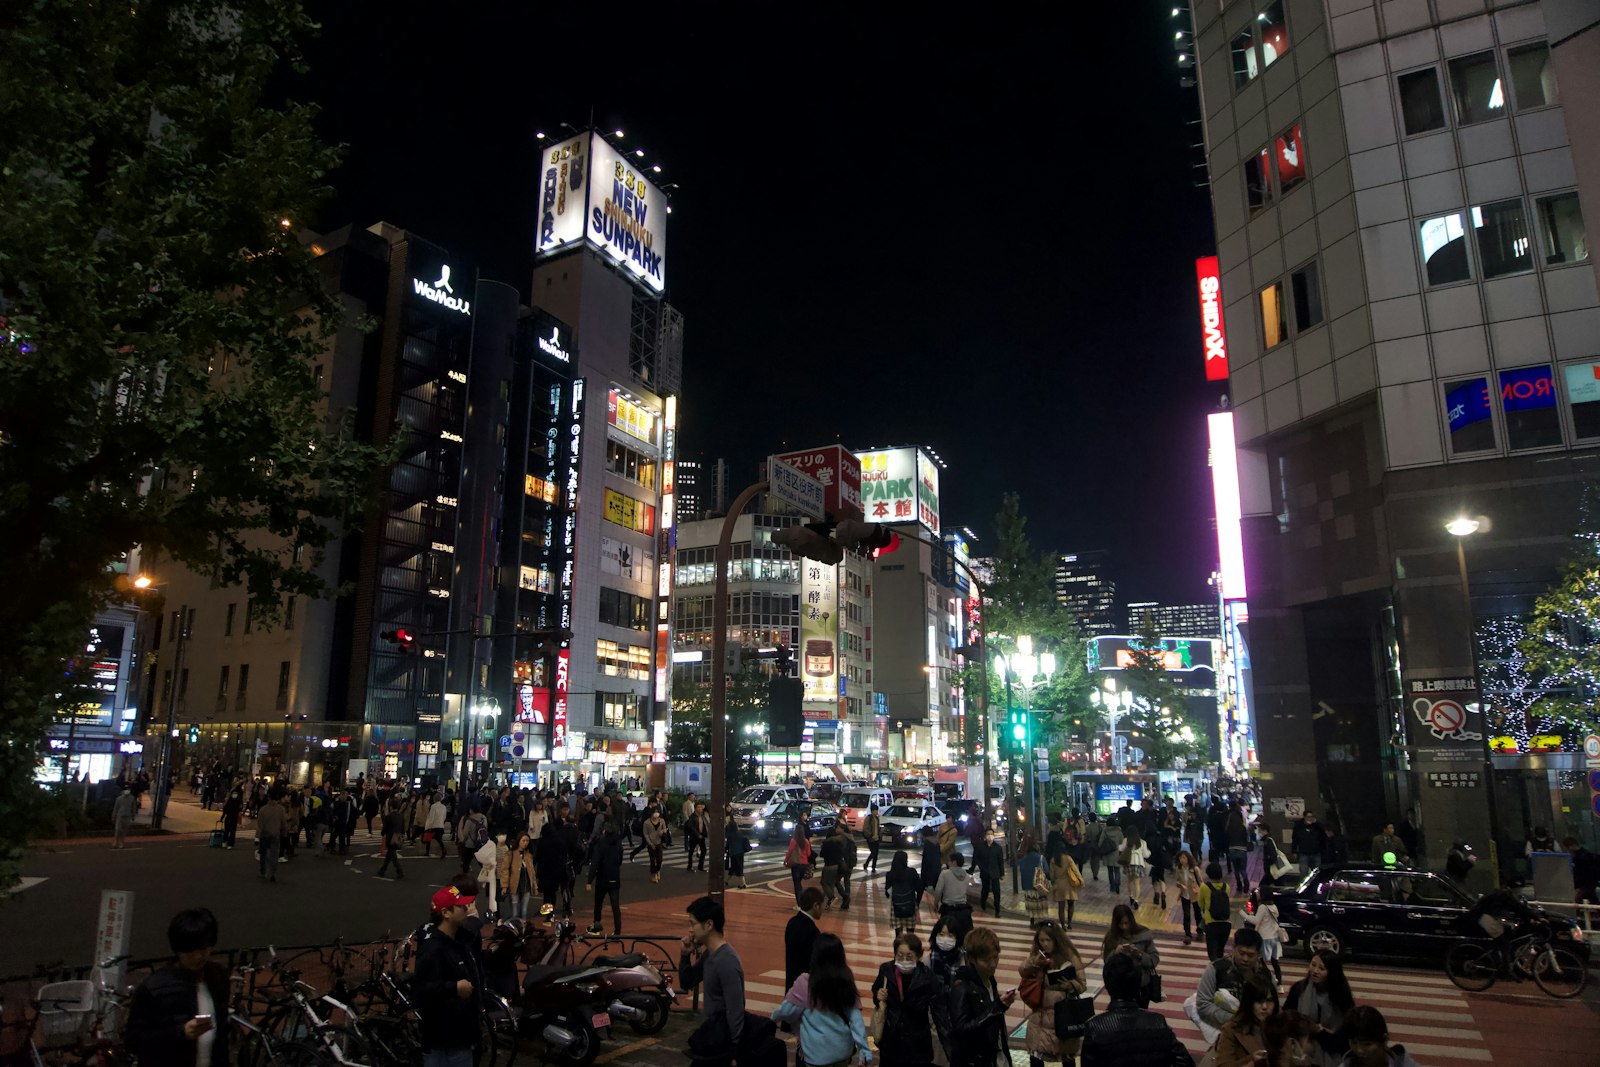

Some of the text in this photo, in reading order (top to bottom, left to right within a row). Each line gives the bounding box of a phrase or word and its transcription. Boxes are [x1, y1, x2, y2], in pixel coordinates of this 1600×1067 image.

[604, 197, 653, 248] SHINJUKU
[612, 178, 648, 226] NEW
[592, 207, 662, 281] SUNPARK
[1200, 276, 1226, 360] SHIDAX
[774, 463, 823, 504] 新宿区役所前
[862, 478, 913, 500] PARK
[808, 567, 821, 621] 第一酵素
[557, 656, 568, 691] KFC
[1412, 678, 1477, 692] 路上喫煙禁止
[1099, 803, 1110, 812] 15
